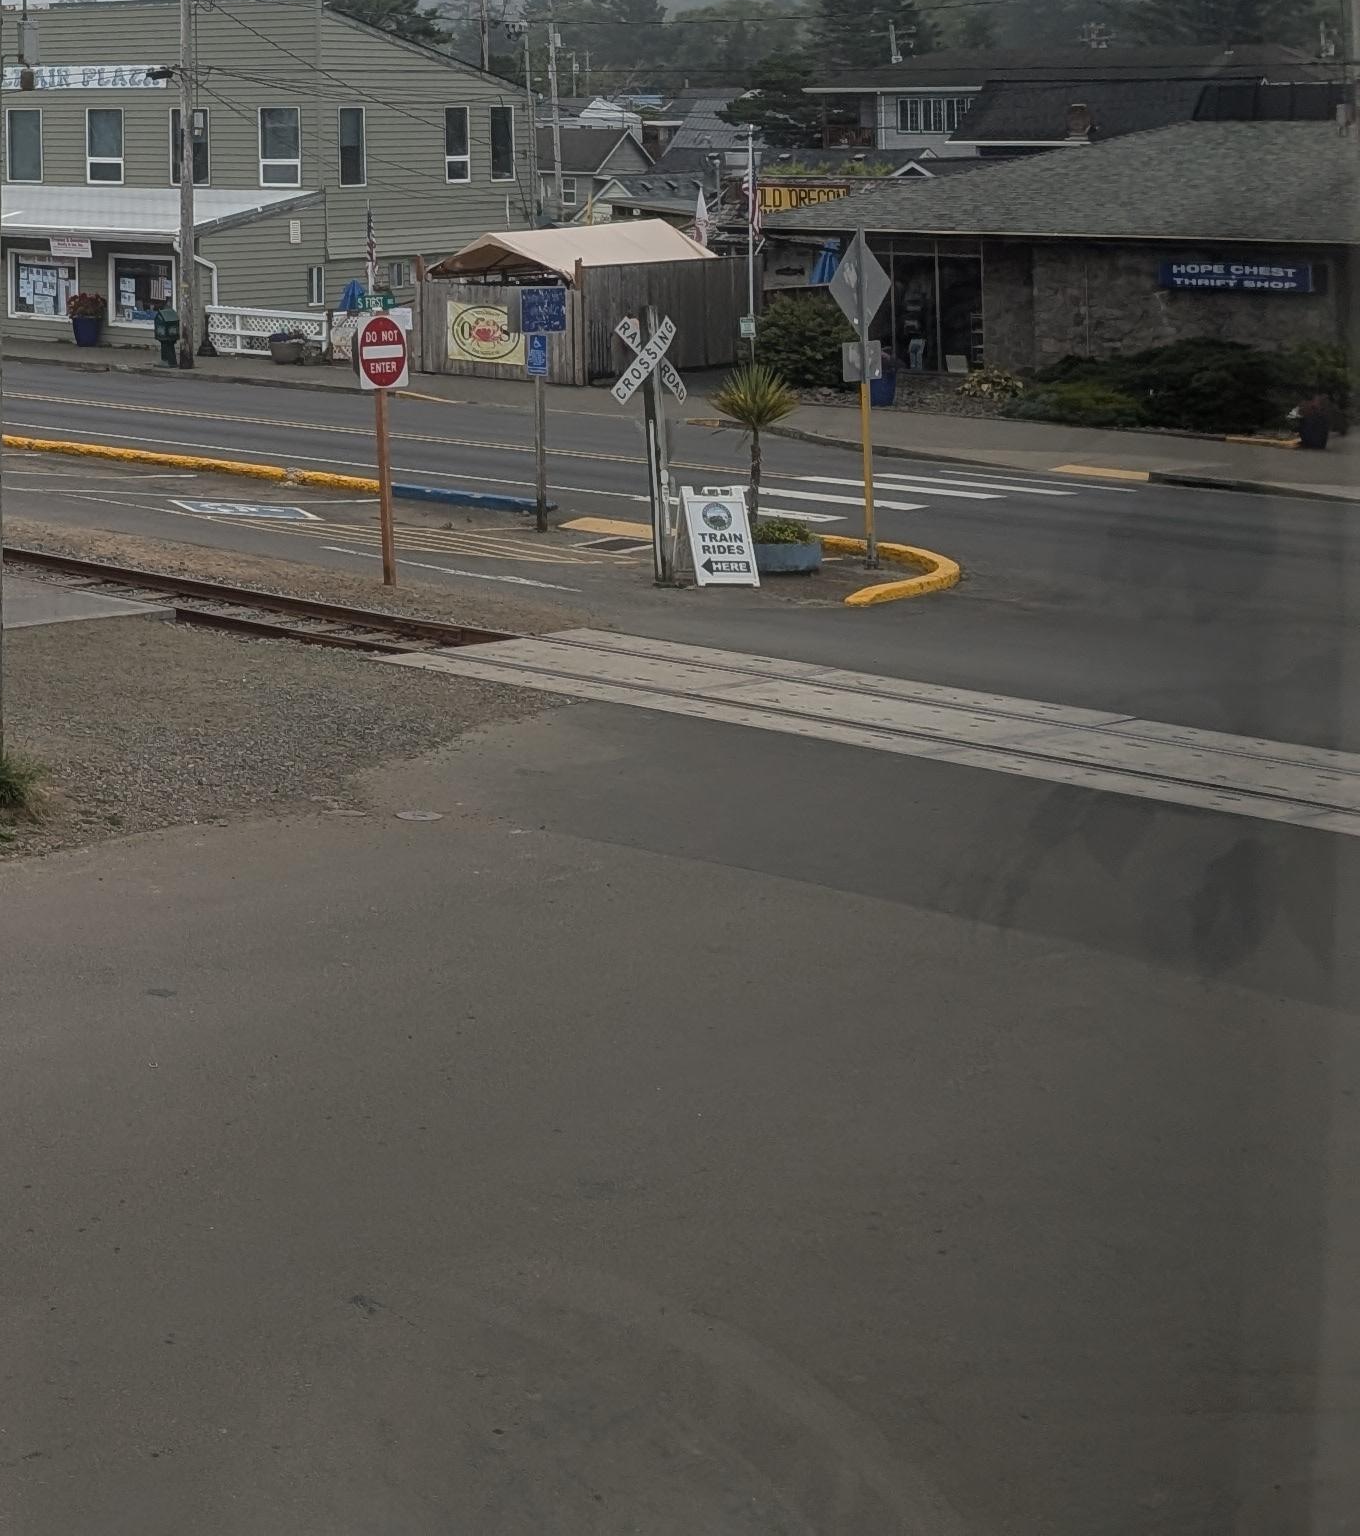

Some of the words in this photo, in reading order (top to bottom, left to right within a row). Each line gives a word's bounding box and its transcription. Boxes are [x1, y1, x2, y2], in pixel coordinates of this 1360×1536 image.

[1172, 264, 1225, 274] HOPE
[1230, 265, 1297, 278] CHEST
[1172, 277, 1238, 288] THRIFT
[1243, 280, 1297, 289] SHOP
[357, 297, 364, 309] S
[365, 295, 384, 309] FIRST
[365, 331, 378, 343] DO
[381, 330, 398, 342] NOT
[615, 321, 674, 400] CROSSING
[370, 361, 397, 374] ENTER
[661, 364, 685, 401] ROAD
[698, 532, 744, 543] TRAIN
[701, 545, 745, 555] RIDES
[711, 562, 748, 572] HERE
